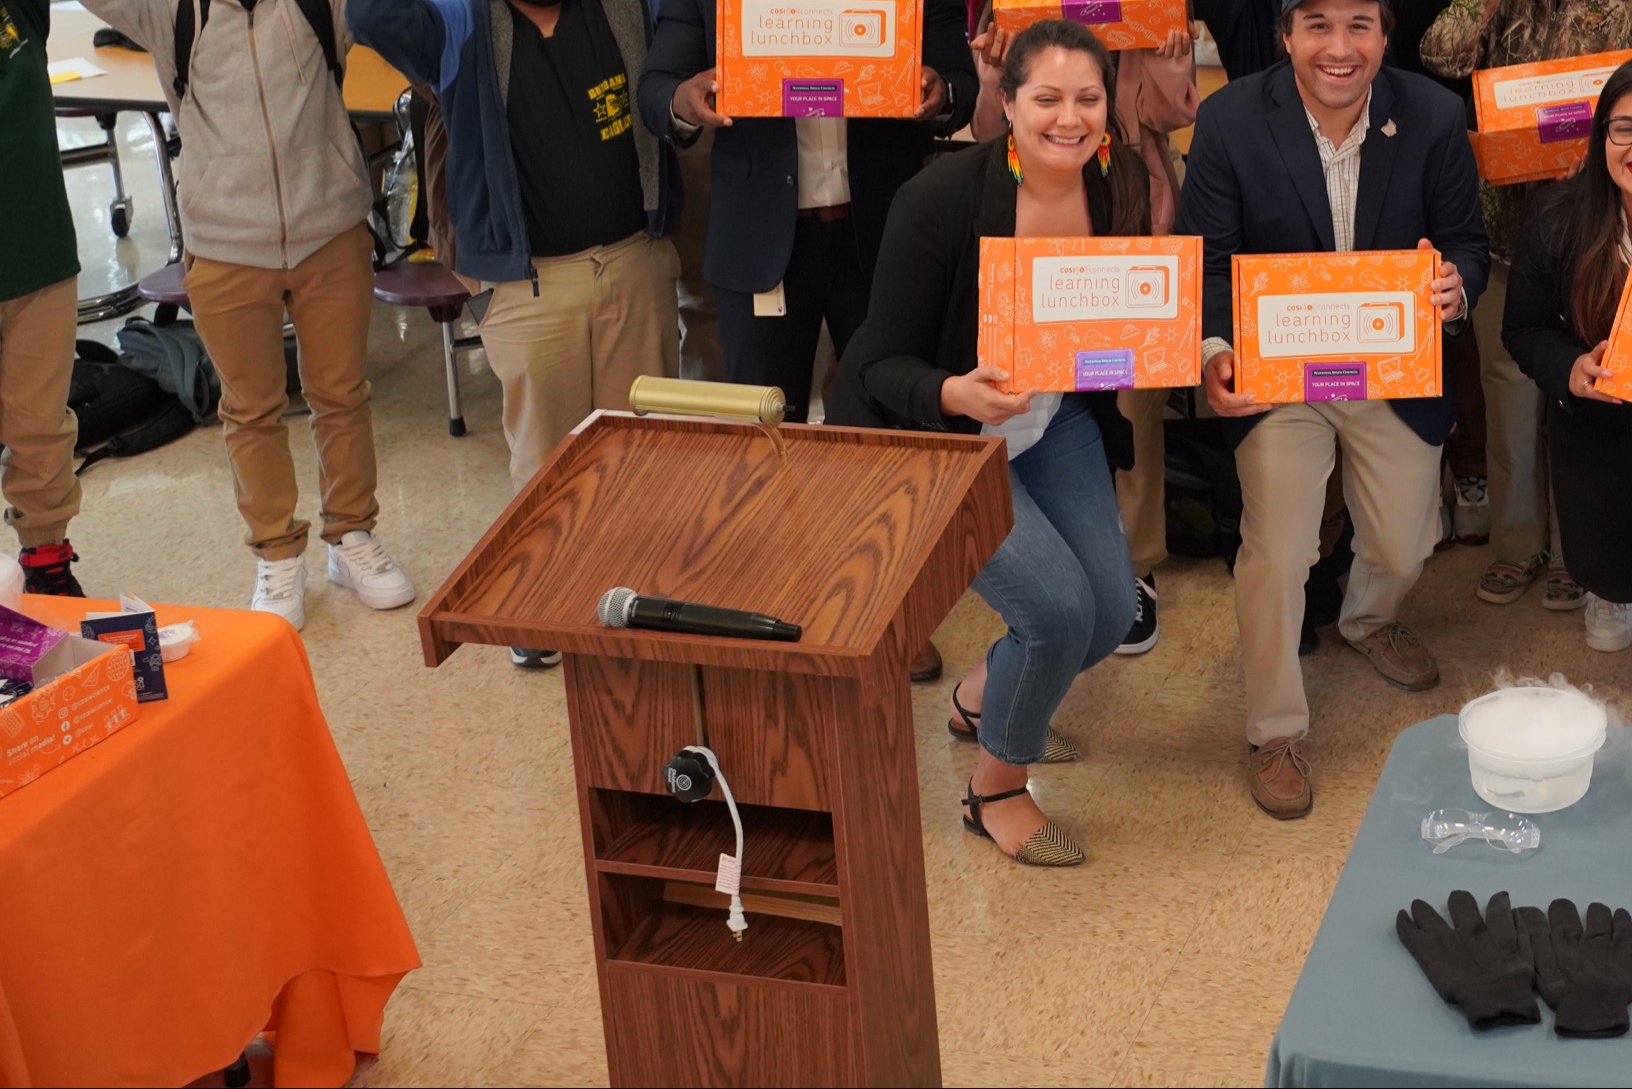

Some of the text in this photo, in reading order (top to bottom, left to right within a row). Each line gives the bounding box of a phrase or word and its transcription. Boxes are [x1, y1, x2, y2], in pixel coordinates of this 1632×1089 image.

[759, 16, 833, 33] learning
[751, 31, 833, 45] lunchbox
[1050, 276, 1120, 291] learning
[1042, 293, 1120, 308] lunchbox
[1276, 314, 1351, 329] learning
[1268, 329, 1351, 344] lunchbox
[7, 736, 39, 756] Share on
[9, 734, 56, 765] social media!
